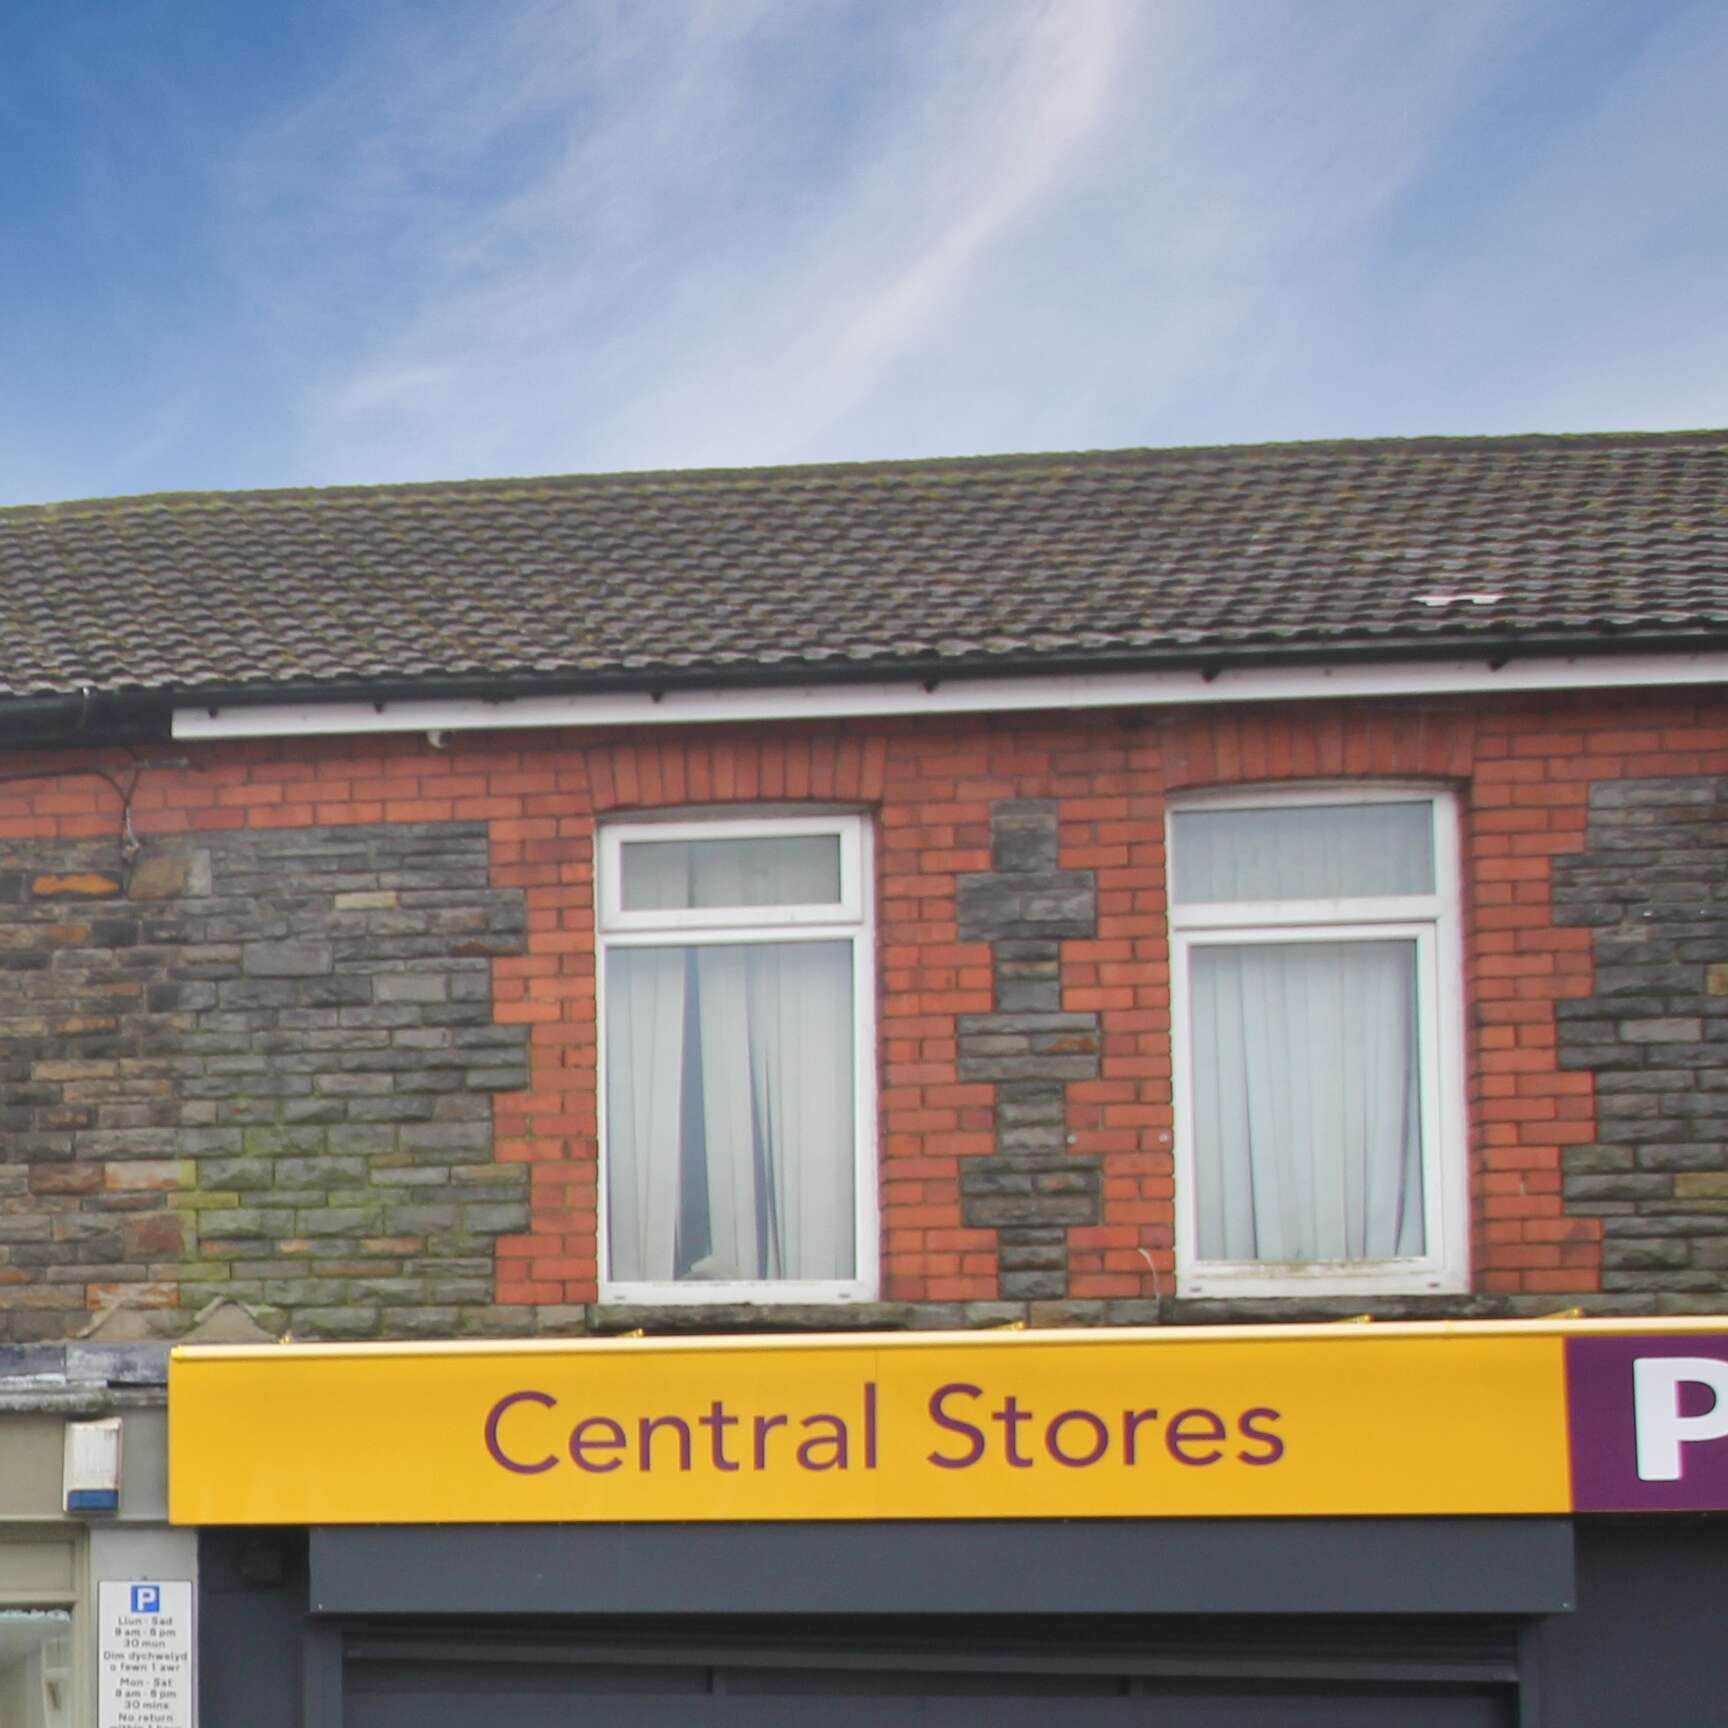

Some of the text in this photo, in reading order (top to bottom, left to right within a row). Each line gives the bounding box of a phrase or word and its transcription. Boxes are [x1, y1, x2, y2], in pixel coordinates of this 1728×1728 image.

[483, 1381, 1285, 1475] Central Stores
[137, 1587, 157, 1612] P
[119, 1677, 144, 1688] Mon
[152, 1677, 173, 1688] Sat
[118, 1712, 174, 1722] No return
